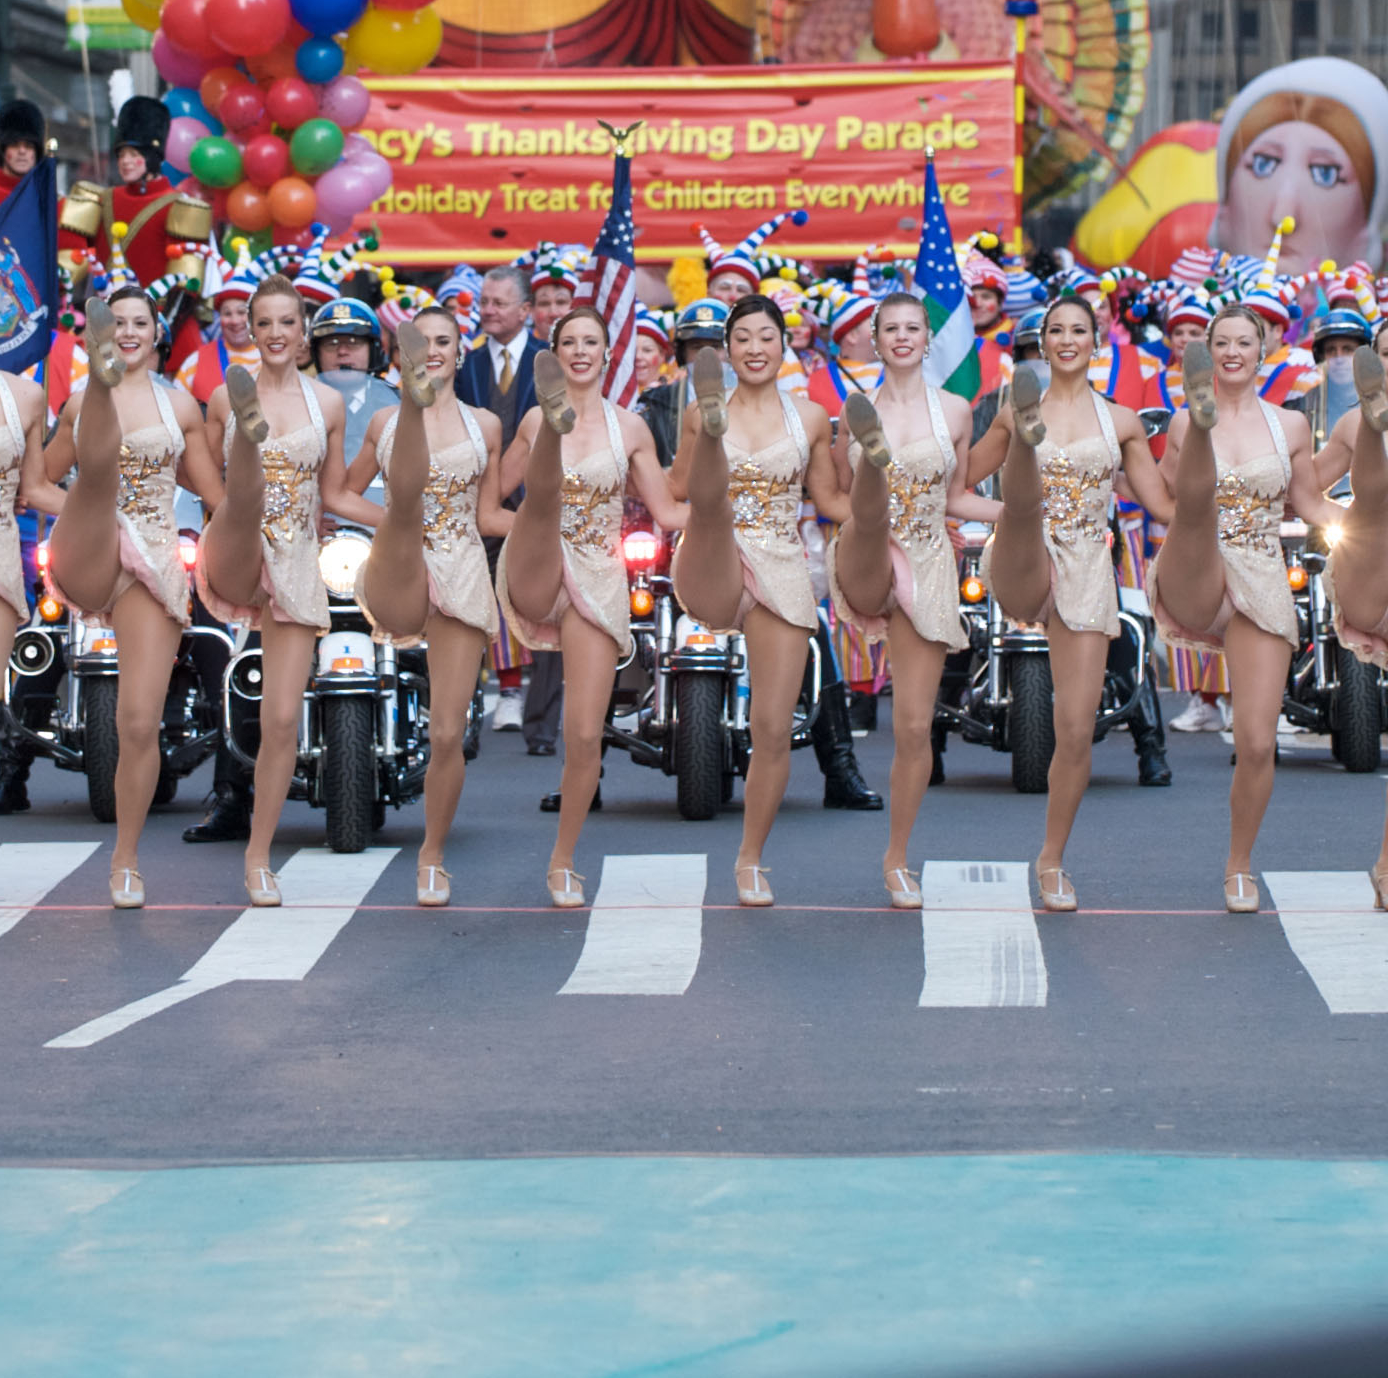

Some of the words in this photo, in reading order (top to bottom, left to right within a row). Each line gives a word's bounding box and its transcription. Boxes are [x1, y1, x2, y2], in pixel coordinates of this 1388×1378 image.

[358, 122, 454, 165] acy's
[746, 119, 825, 159] Day
[837, 113, 980, 151] Parade
[499, 183, 580, 213] Treat
[588, 181, 635, 213] fo
[644, 180, 777, 210] Children
